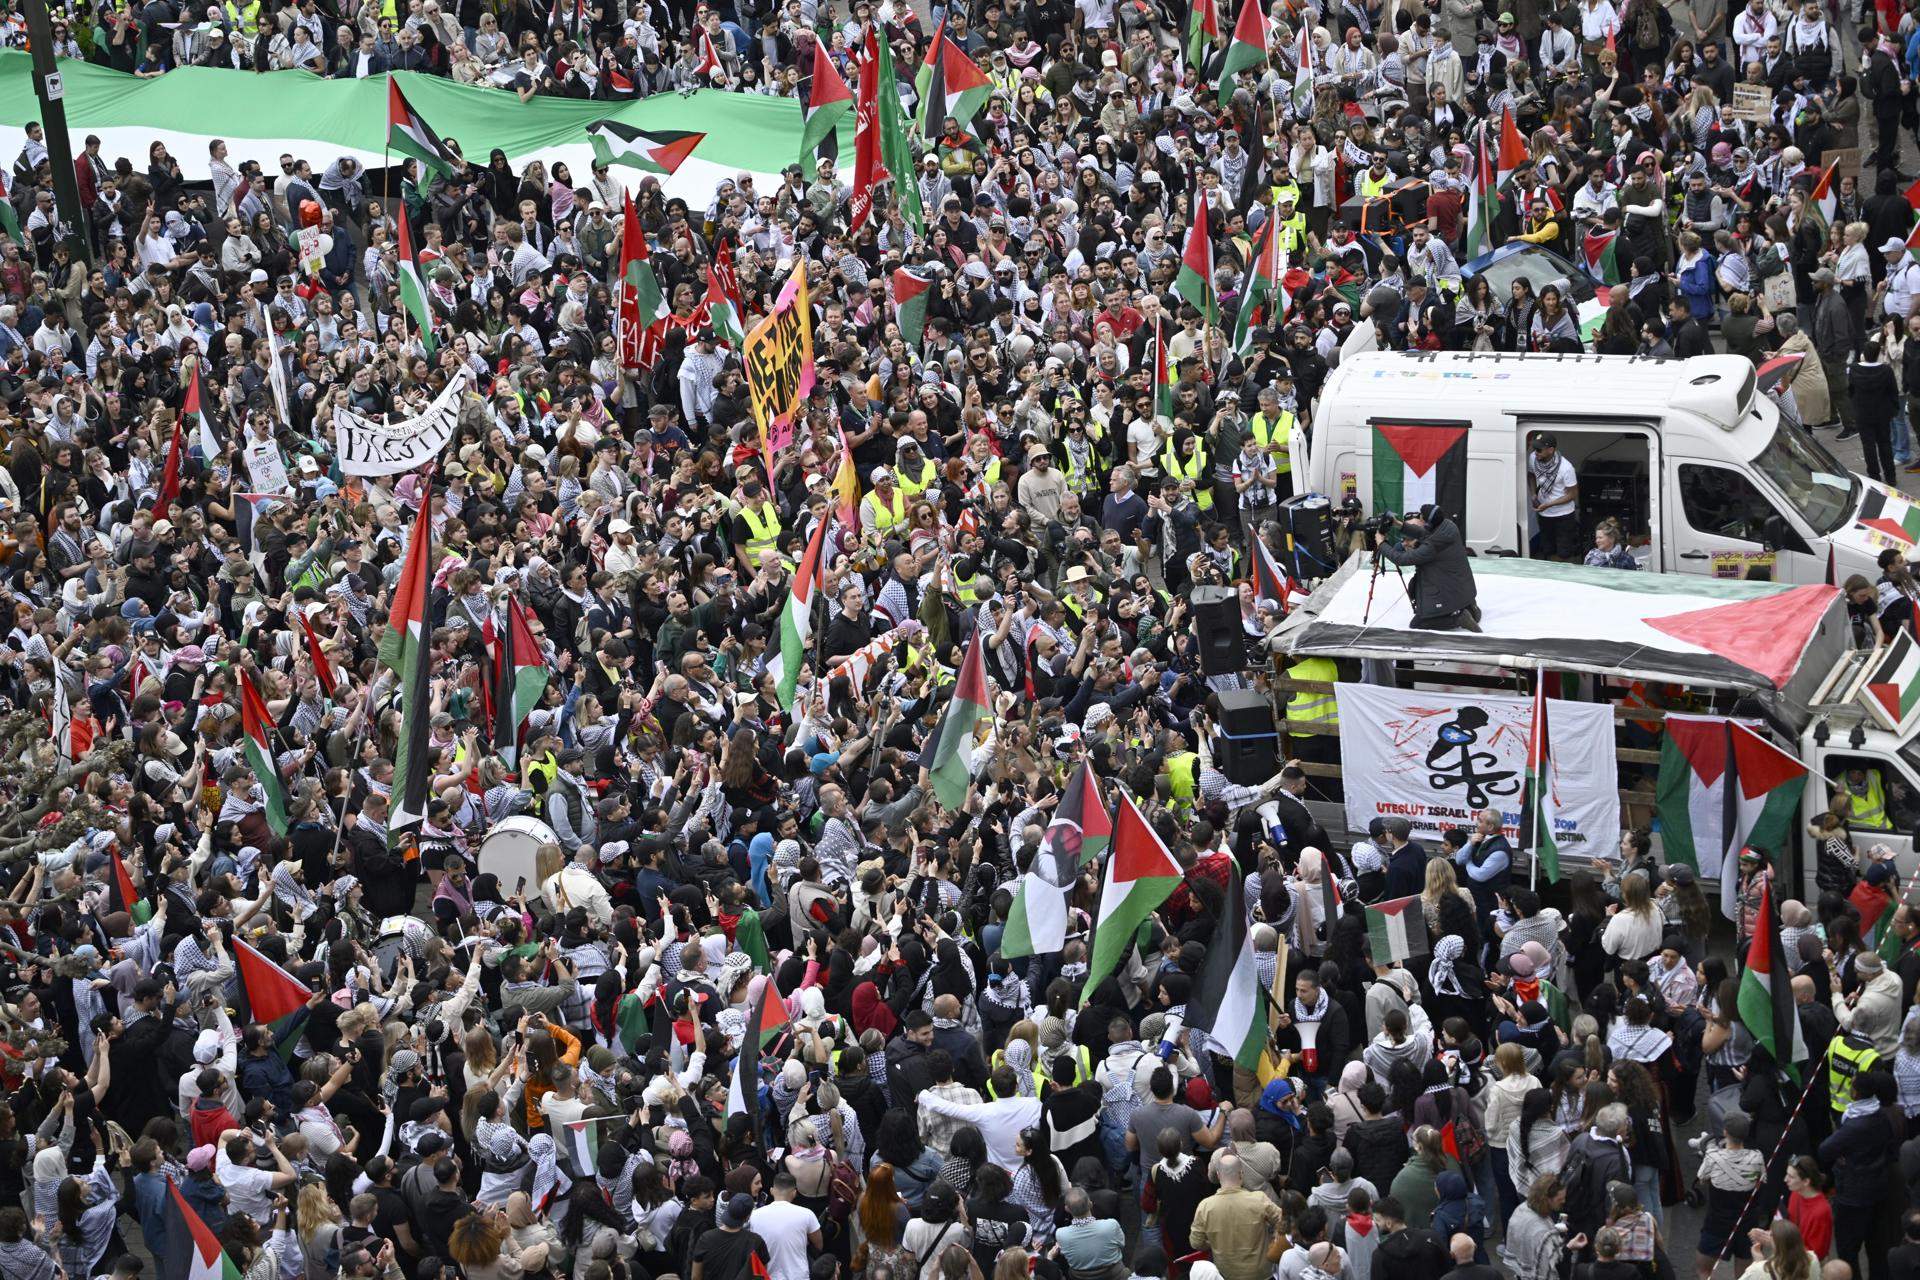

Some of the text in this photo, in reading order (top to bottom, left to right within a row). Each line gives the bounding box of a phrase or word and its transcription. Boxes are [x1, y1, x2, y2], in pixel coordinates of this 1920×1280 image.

[1376, 802, 1426, 816] UTESLUT
[1427, 806, 1468, 819] ISRAEL
[1555, 831, 1587, 842] ESTINA
